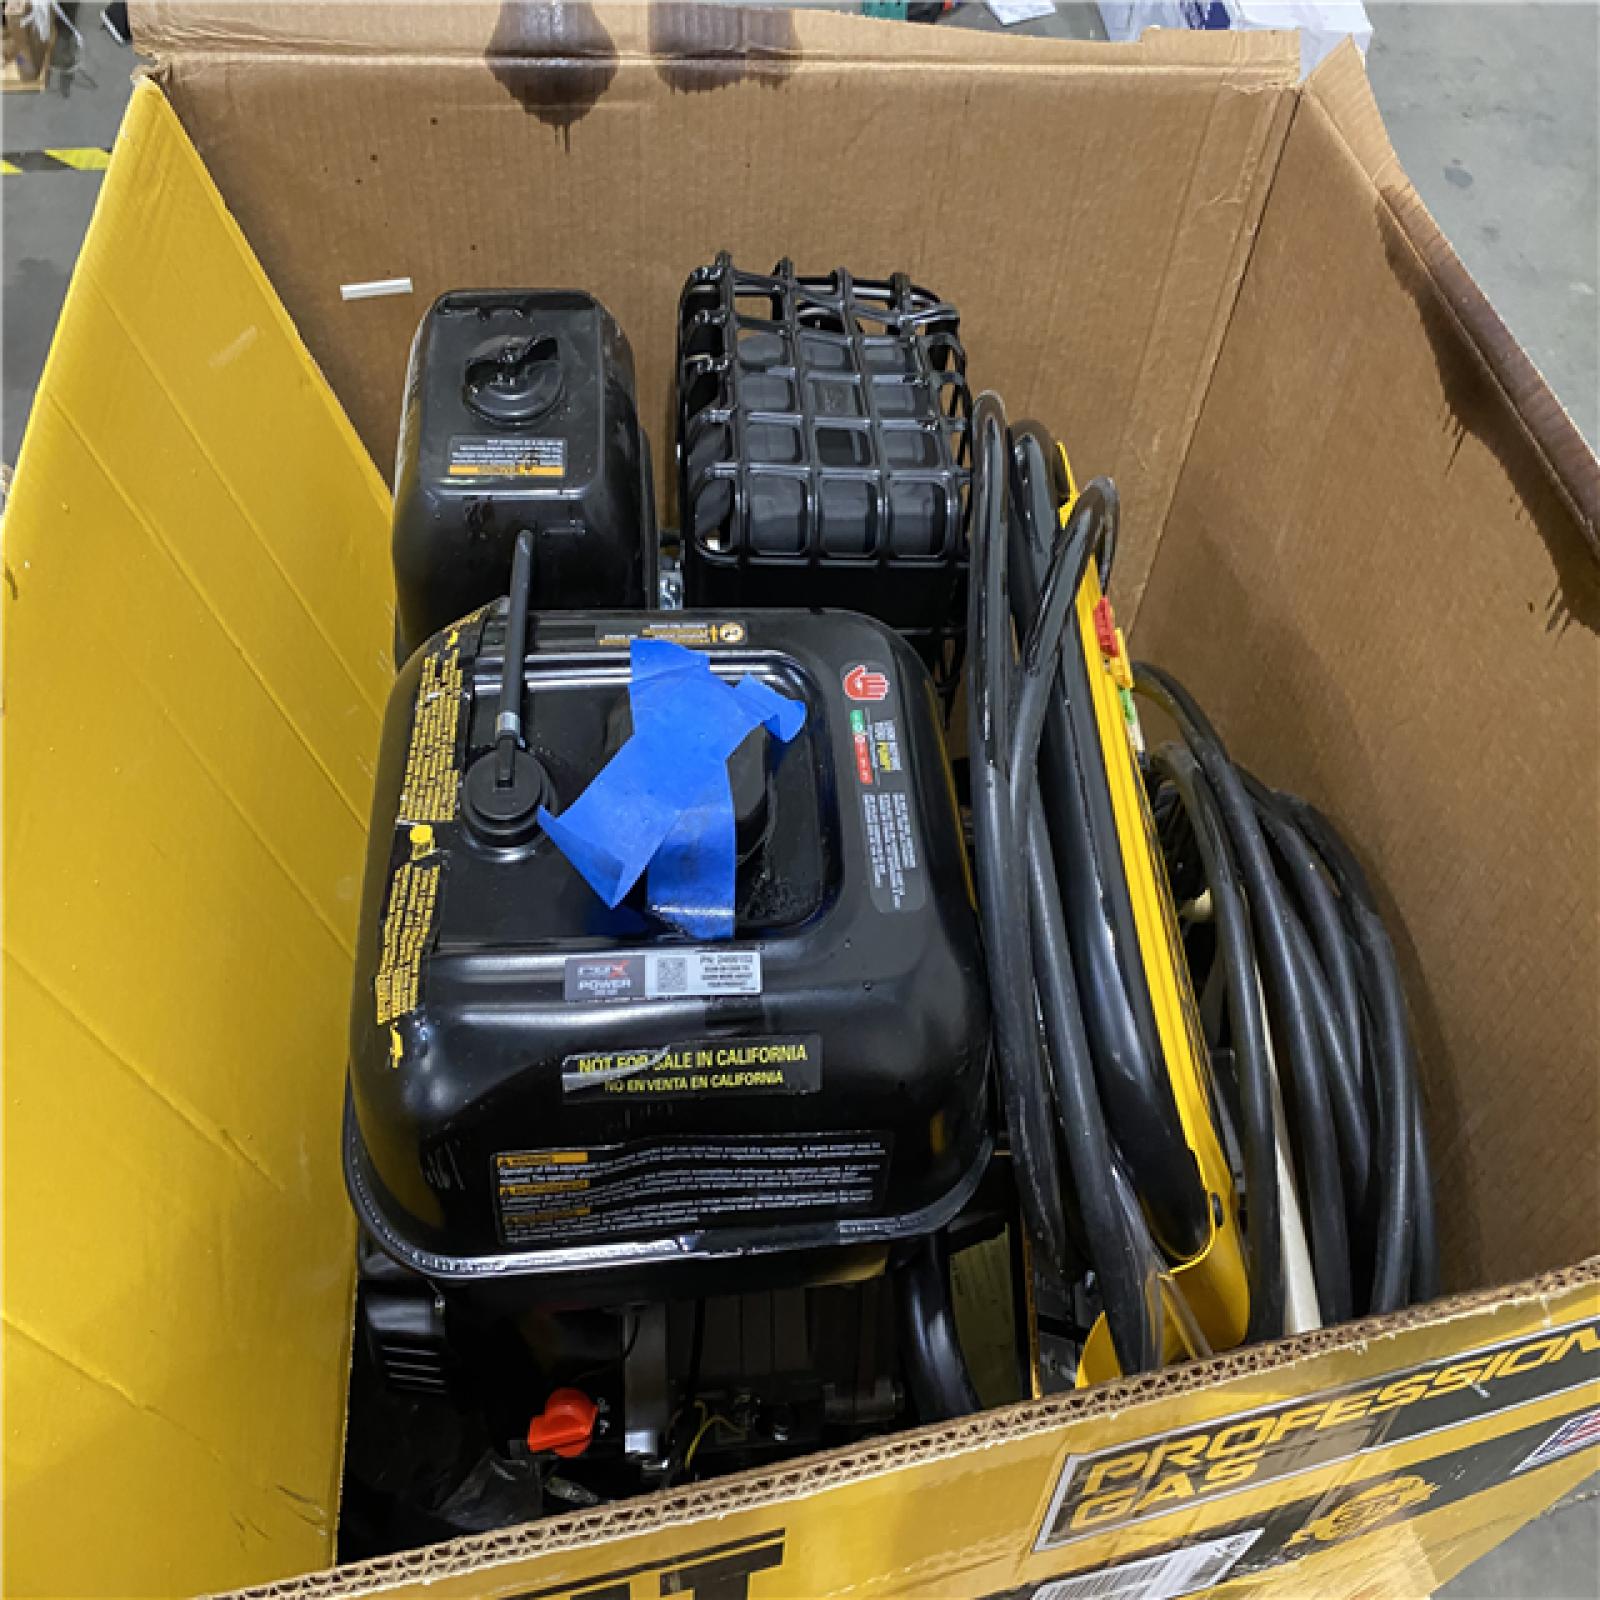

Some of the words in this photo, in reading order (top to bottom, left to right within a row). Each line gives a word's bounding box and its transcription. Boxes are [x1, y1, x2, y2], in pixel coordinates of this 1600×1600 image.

[579, 1056, 612, 1073] NOT
[696, 1051, 713, 1068] IN
[716, 1044, 808, 1066] CALIFORNIA
[690, 1074, 708, 1090] EN
[710, 1070, 784, 1088] CALIFORNIA
[1070, 1452, 1259, 1529] GAS
